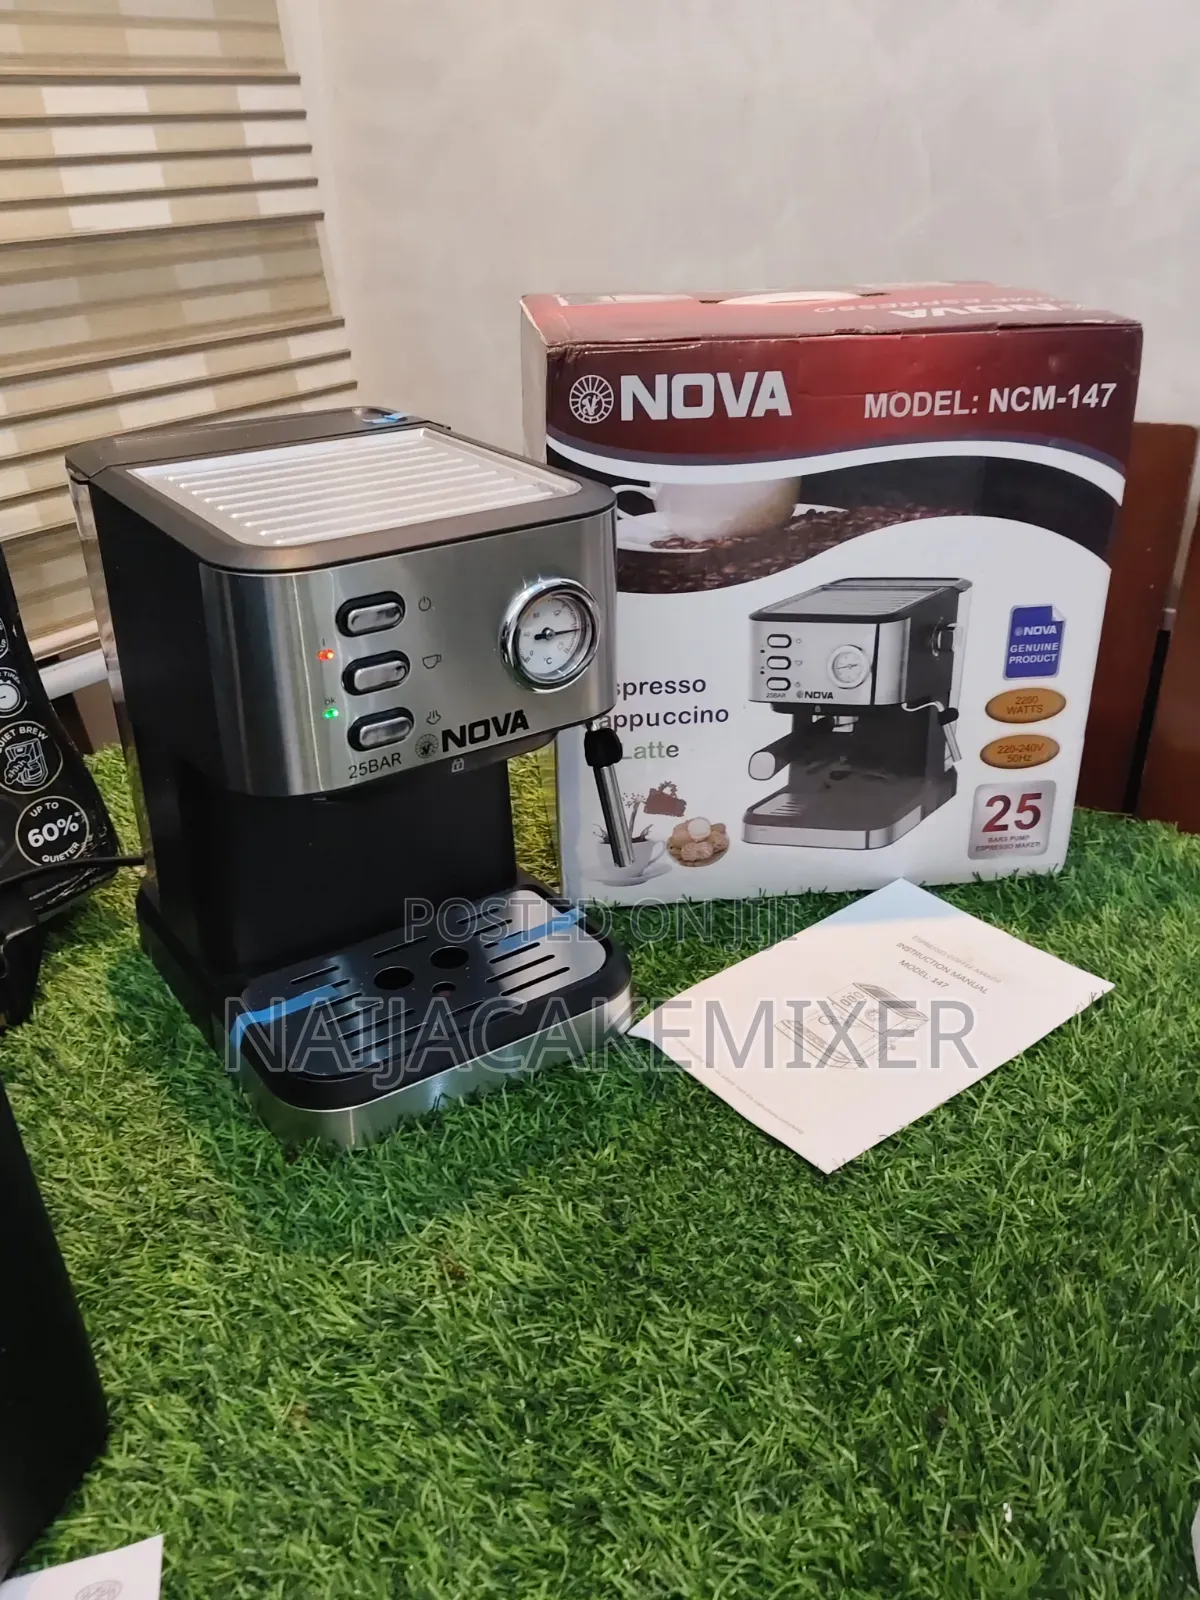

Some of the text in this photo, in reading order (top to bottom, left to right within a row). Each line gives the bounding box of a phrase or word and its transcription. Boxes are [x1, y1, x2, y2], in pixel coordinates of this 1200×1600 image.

[888, 302, 1062, 319] NOVA
[621, 371, 1117, 421] NOVA MODEL: NCM-147
[1023, 625, 1057, 636] NOVA
[1010, 642, 1059, 653] GENUINE
[1009, 653, 1058, 664] PRODUCT
[617, 679, 707, 701] presso
[804, 691, 834, 699] NOVA
[1006, 704, 1043, 715] WATTS
[441, 709, 529, 752] NOVA
[0, 726, 48, 754] UIET BREW
[997, 743, 1044, 755] 220-240V
[348, 752, 402, 779] 25BAR
[1007, 754, 1032, 763] 50Hz
[29, 801, 60, 818] UP TO
[982, 792, 1042, 832] 25
[42, 841, 80, 863] QUIETER
[1015, 841, 1041, 849] MAKER
[896, 942, 989, 995] INSTRUCTION MANUAL
[931, 977, 950, 988] 147
